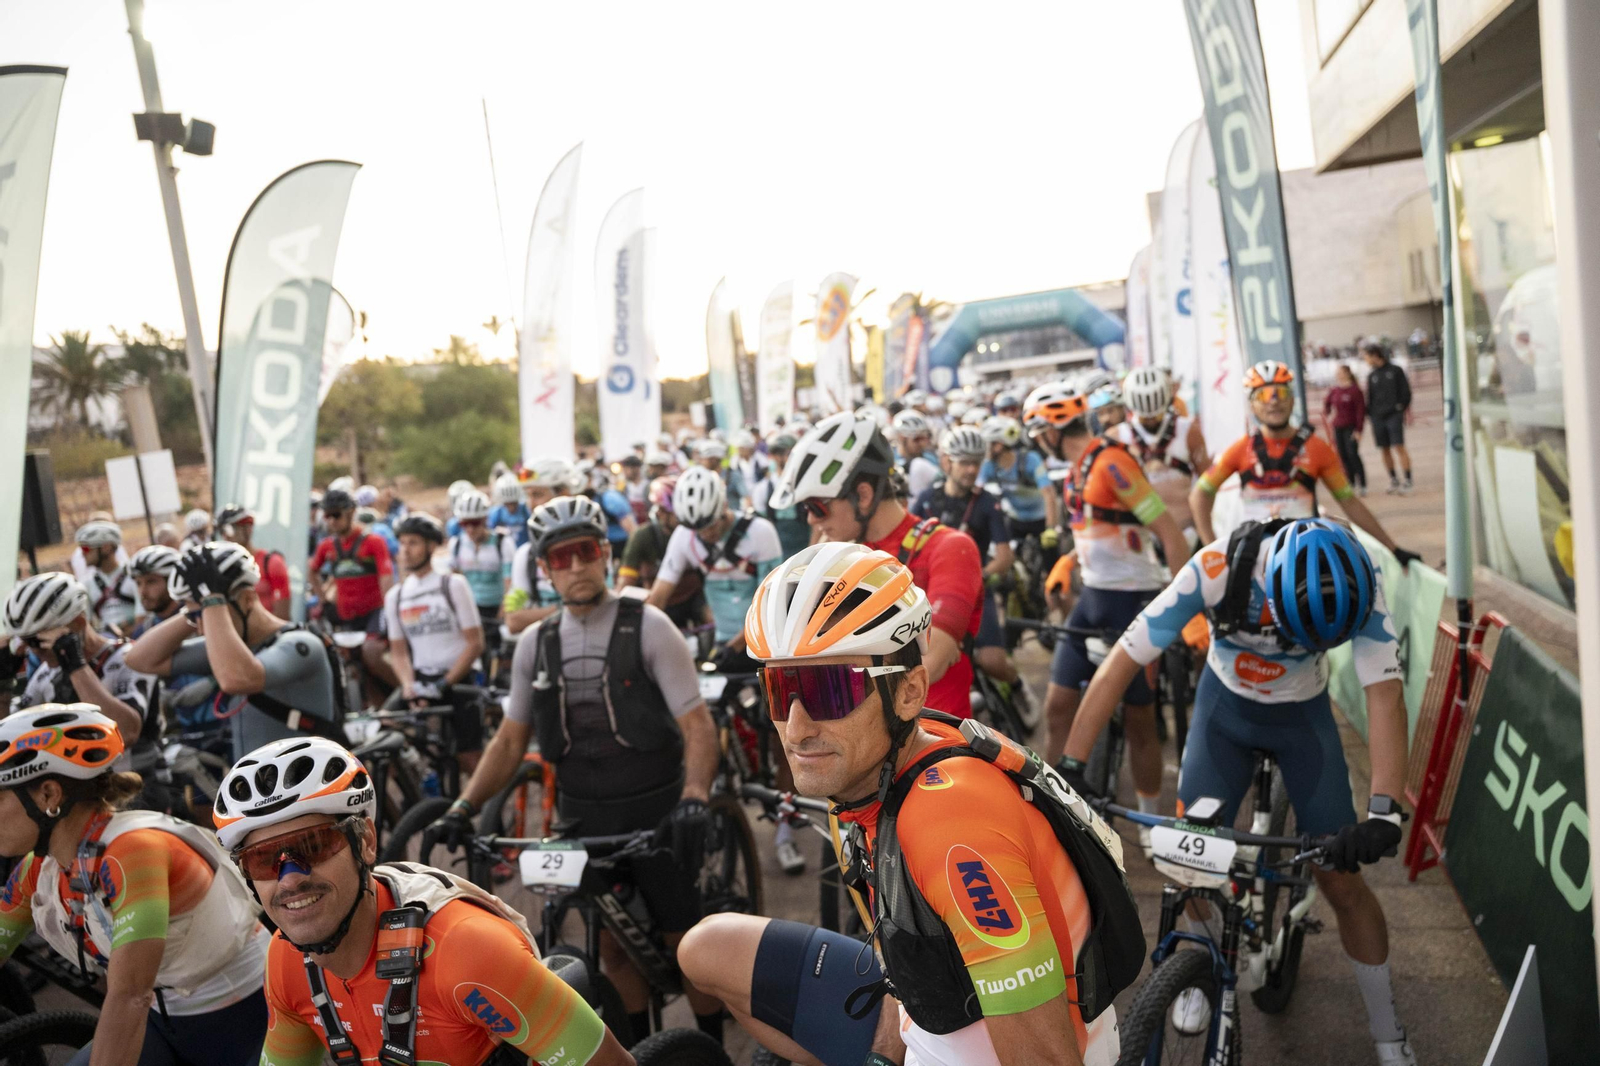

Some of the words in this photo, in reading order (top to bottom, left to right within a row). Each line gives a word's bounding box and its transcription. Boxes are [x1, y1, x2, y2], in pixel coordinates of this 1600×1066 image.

[0, 760, 48, 782] atlike
[254, 794, 283, 808] catlike
[1177, 835, 1206, 856] 49
[541, 853, 564, 870] 29
[385, 1044, 411, 1057] USWE
